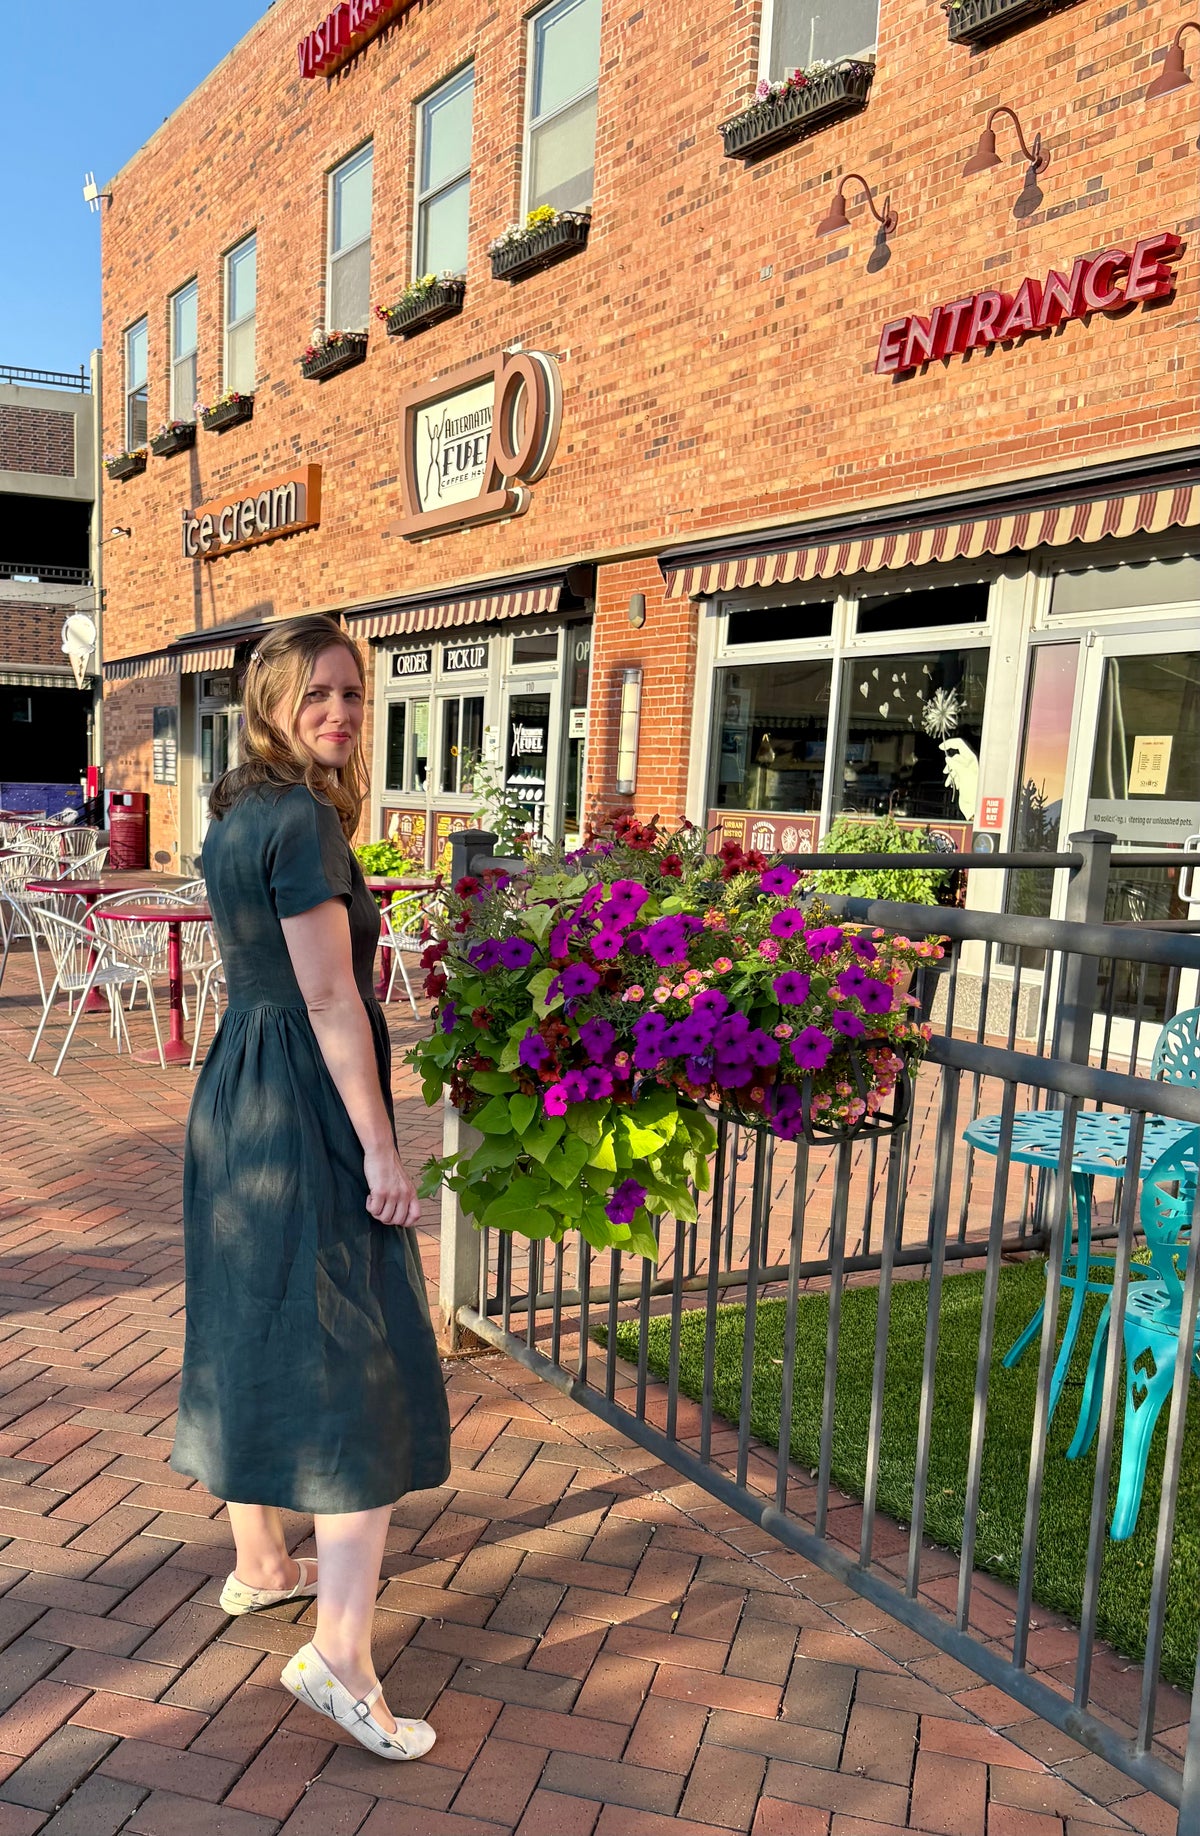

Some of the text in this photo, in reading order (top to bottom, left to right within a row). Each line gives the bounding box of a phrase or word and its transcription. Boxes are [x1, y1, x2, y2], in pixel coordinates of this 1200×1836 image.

[298, 0, 380, 78] VISIT RA
[875, 232, 1179, 375] ENTRANCE
[440, 472, 469, 488] COFFEE
[182, 481, 300, 557] ice cream
[396, 653, 428, 675] ORDER
[446, 647, 485, 670] PICK UP
[519, 737, 544, 750] FUEL
[723, 829, 743, 838] BISTRO
[724, 820, 743, 829] URBAN
[750, 832, 776, 852] FUEL
